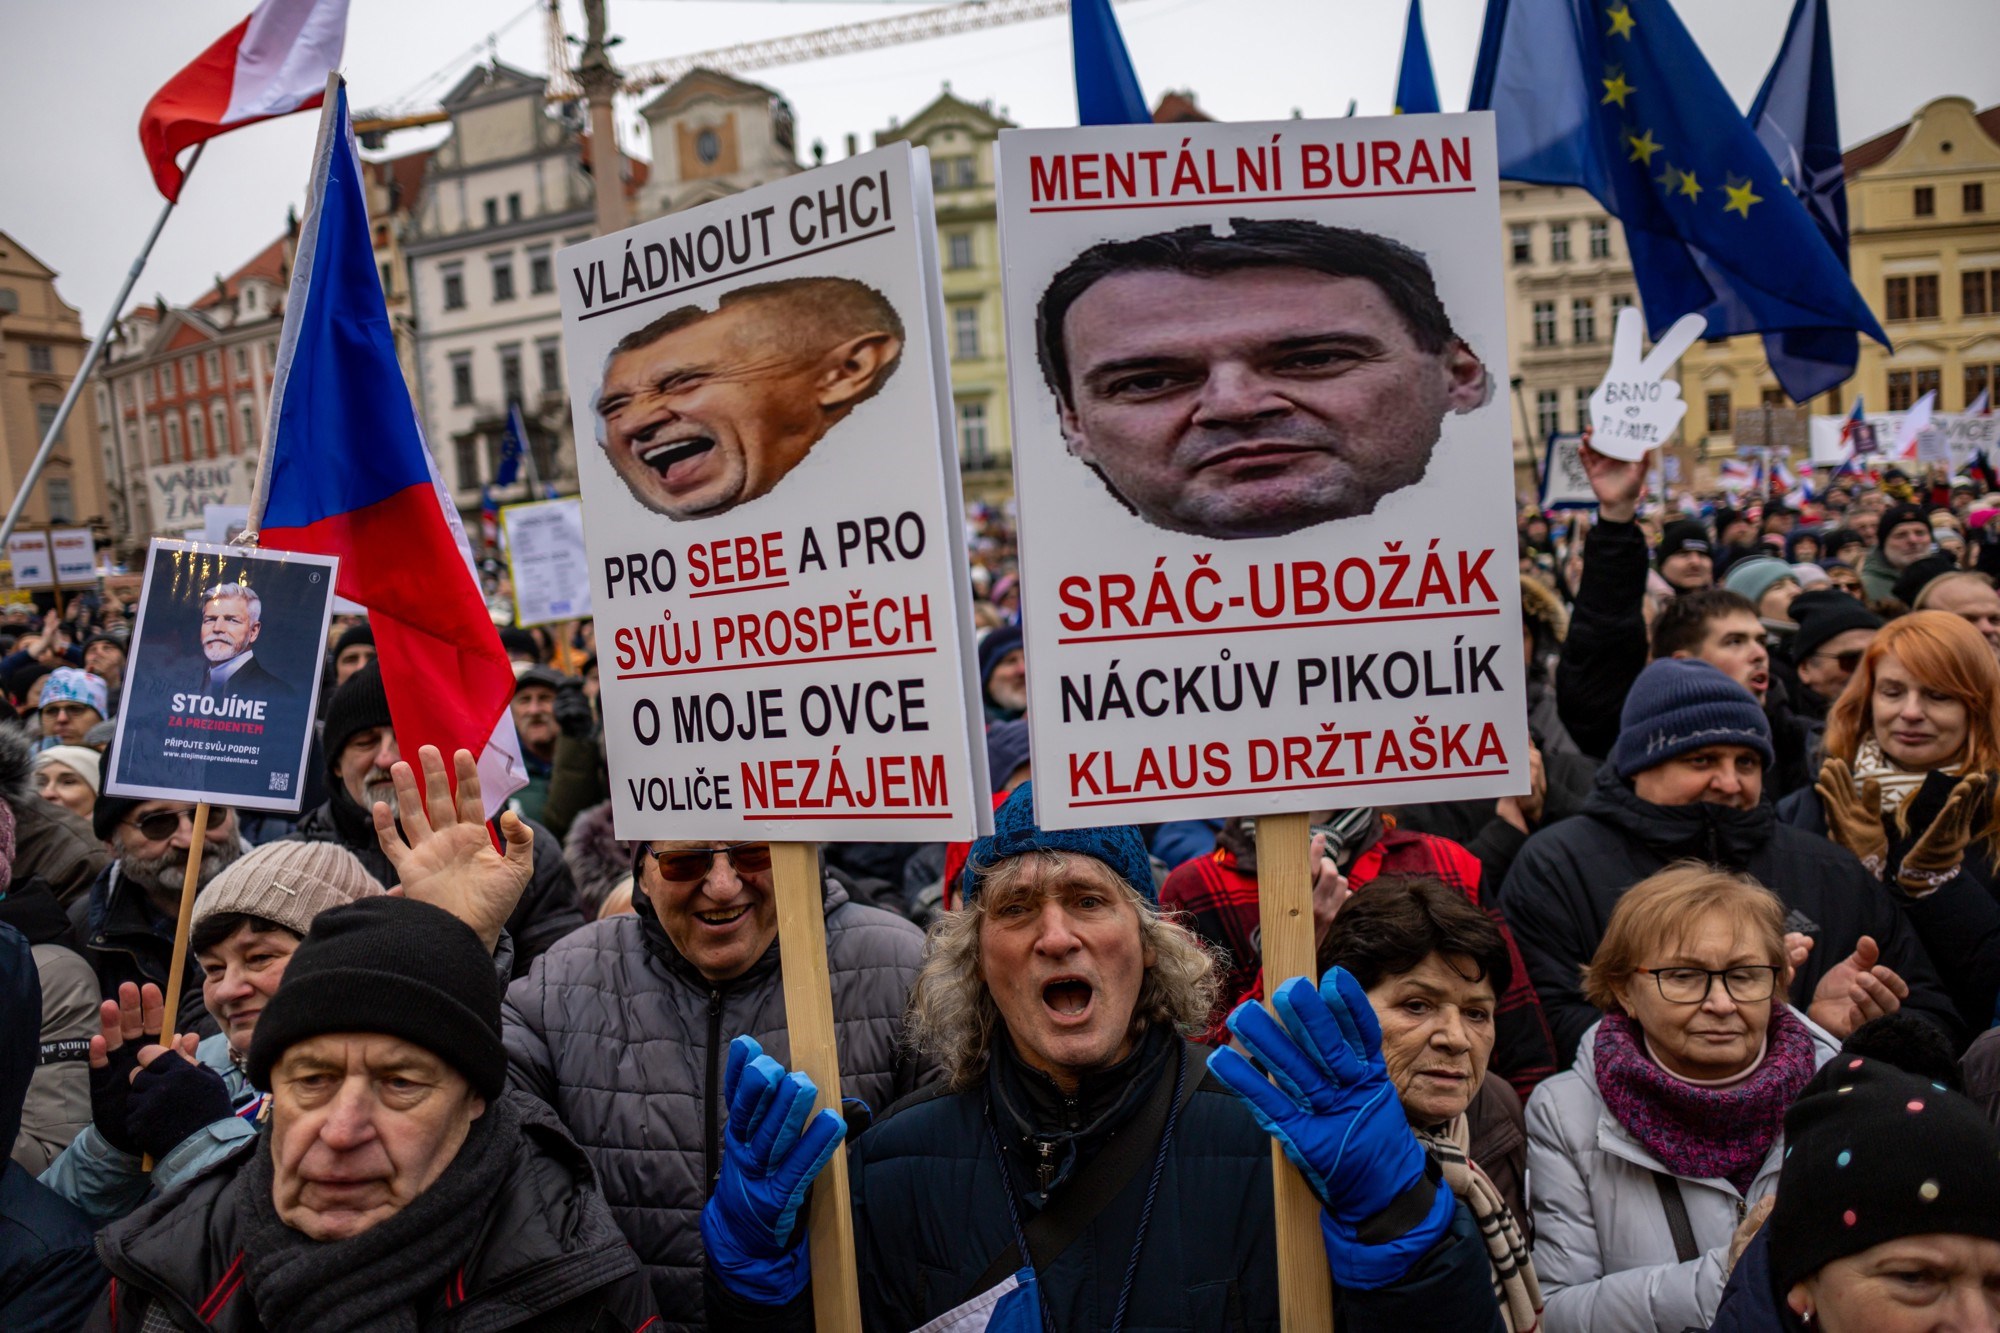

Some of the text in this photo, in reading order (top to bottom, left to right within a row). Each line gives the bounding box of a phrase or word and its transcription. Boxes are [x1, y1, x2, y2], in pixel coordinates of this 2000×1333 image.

[1029, 134, 1472, 202] MENTÁLNÍ BURAN
[573, 170, 892, 309] VLÁDNOUT CHCI
[1605, 381, 1661, 404] BRNO
[605, 548, 676, 598] PRO
[687, 531, 787, 588] SEBE
[799, 527, 827, 574] A
[837, 511, 925, 567] PRO
[1058, 538, 1499, 631] SRÁČ-UBOŽÁK
[615, 590, 932, 670] SVŮJ PROSPĚCH
[172, 693, 267, 720] STOJÍME
[632, 678, 929, 746] O MOJE OVCE
[1060, 635, 1504, 723] NÁCKŮV PIKOLÍK
[164, 737, 260, 755] PŘIPOJTE SVŮJ PODPIS!
[168, 716, 264, 735] ZA PREZIDENTEM
[1069, 715, 1508, 797] KLAUS DRŽTAŠKA
[628, 745, 949, 811] VOLIČE NEZÁJEM
